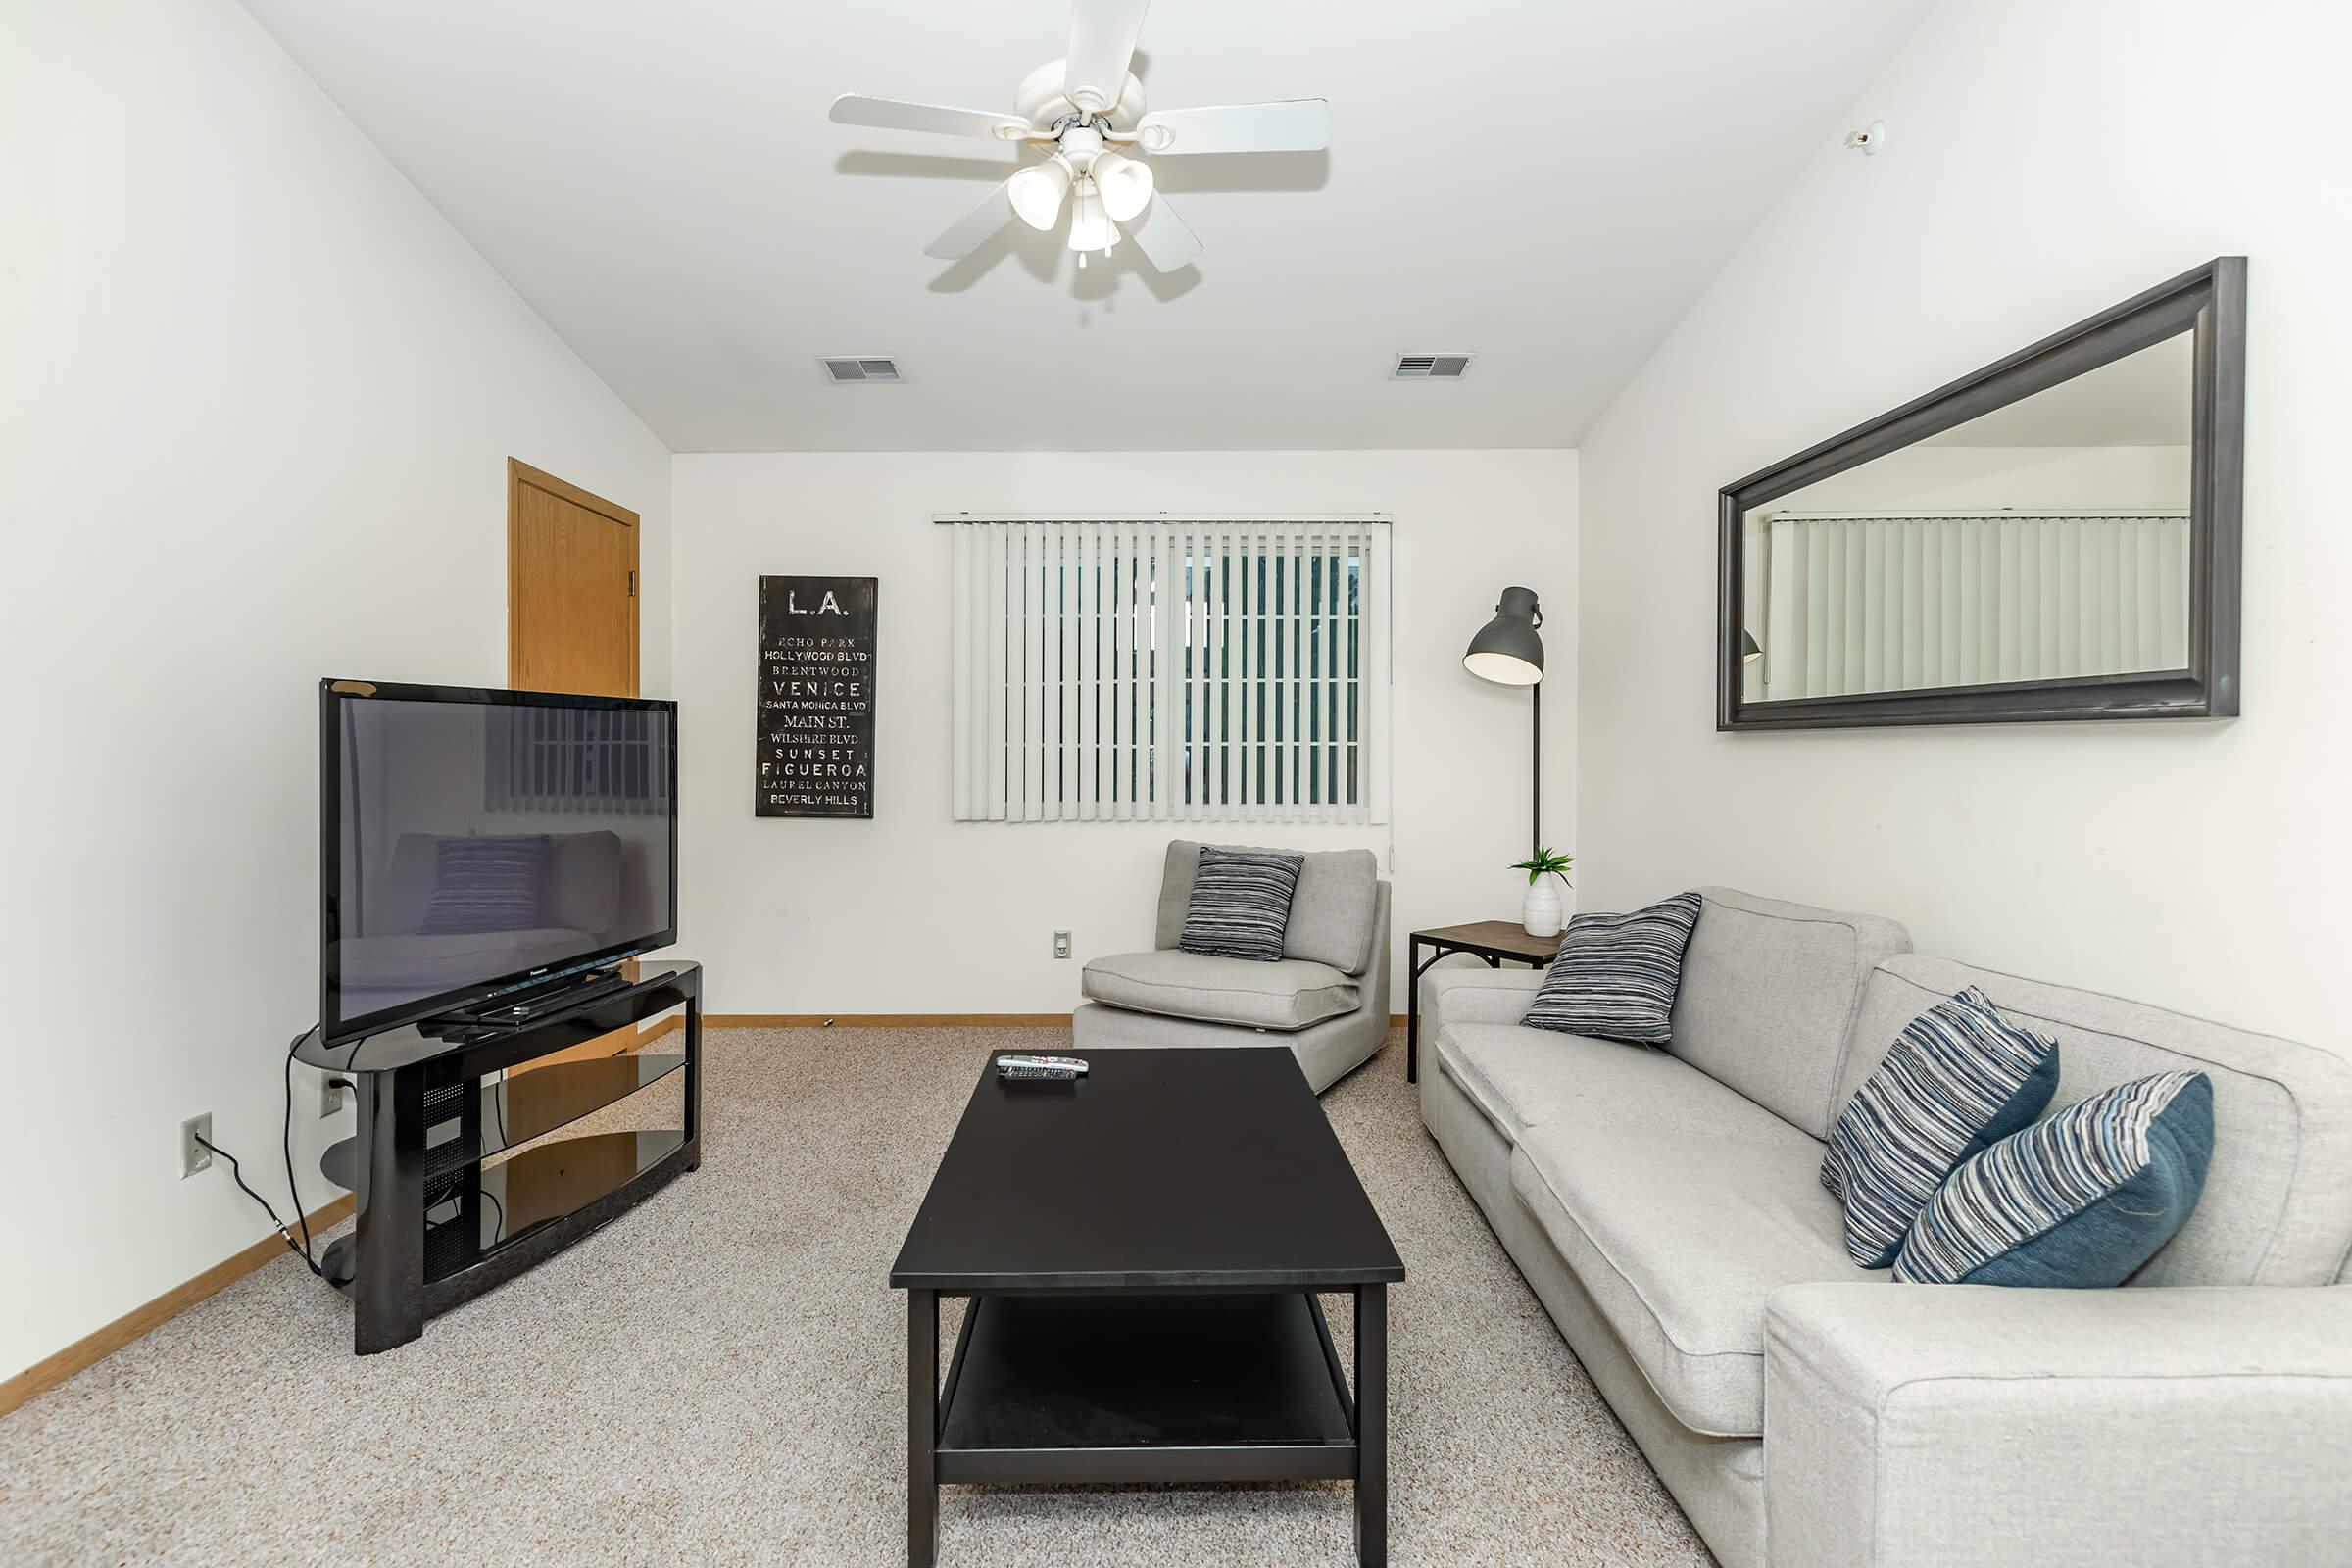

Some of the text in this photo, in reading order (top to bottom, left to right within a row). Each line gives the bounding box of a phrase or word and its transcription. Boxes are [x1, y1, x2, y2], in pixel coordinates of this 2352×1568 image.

[789, 590, 849, 615] L.A.
[778, 637, 814, 648] ECHO
[764, 650, 867, 662] HOLLYWOOD BLVD
[772, 665, 860, 677] BRENTWOOD
[773, 681, 860, 697] VENICE
[766, 700, 866, 710] SANTA MONICA BLVD
[784, 714, 850, 729] MAIN ST.
[770, 733, 858, 745] WILSHIRE BLVD
[775, 748, 854, 760] SUNSET
[761, 762, 867, 777] FIGUEROA
[763, 780, 867, 792] LAUREL CANYON
[770, 794, 858, 806] BEVERLY HILLS
